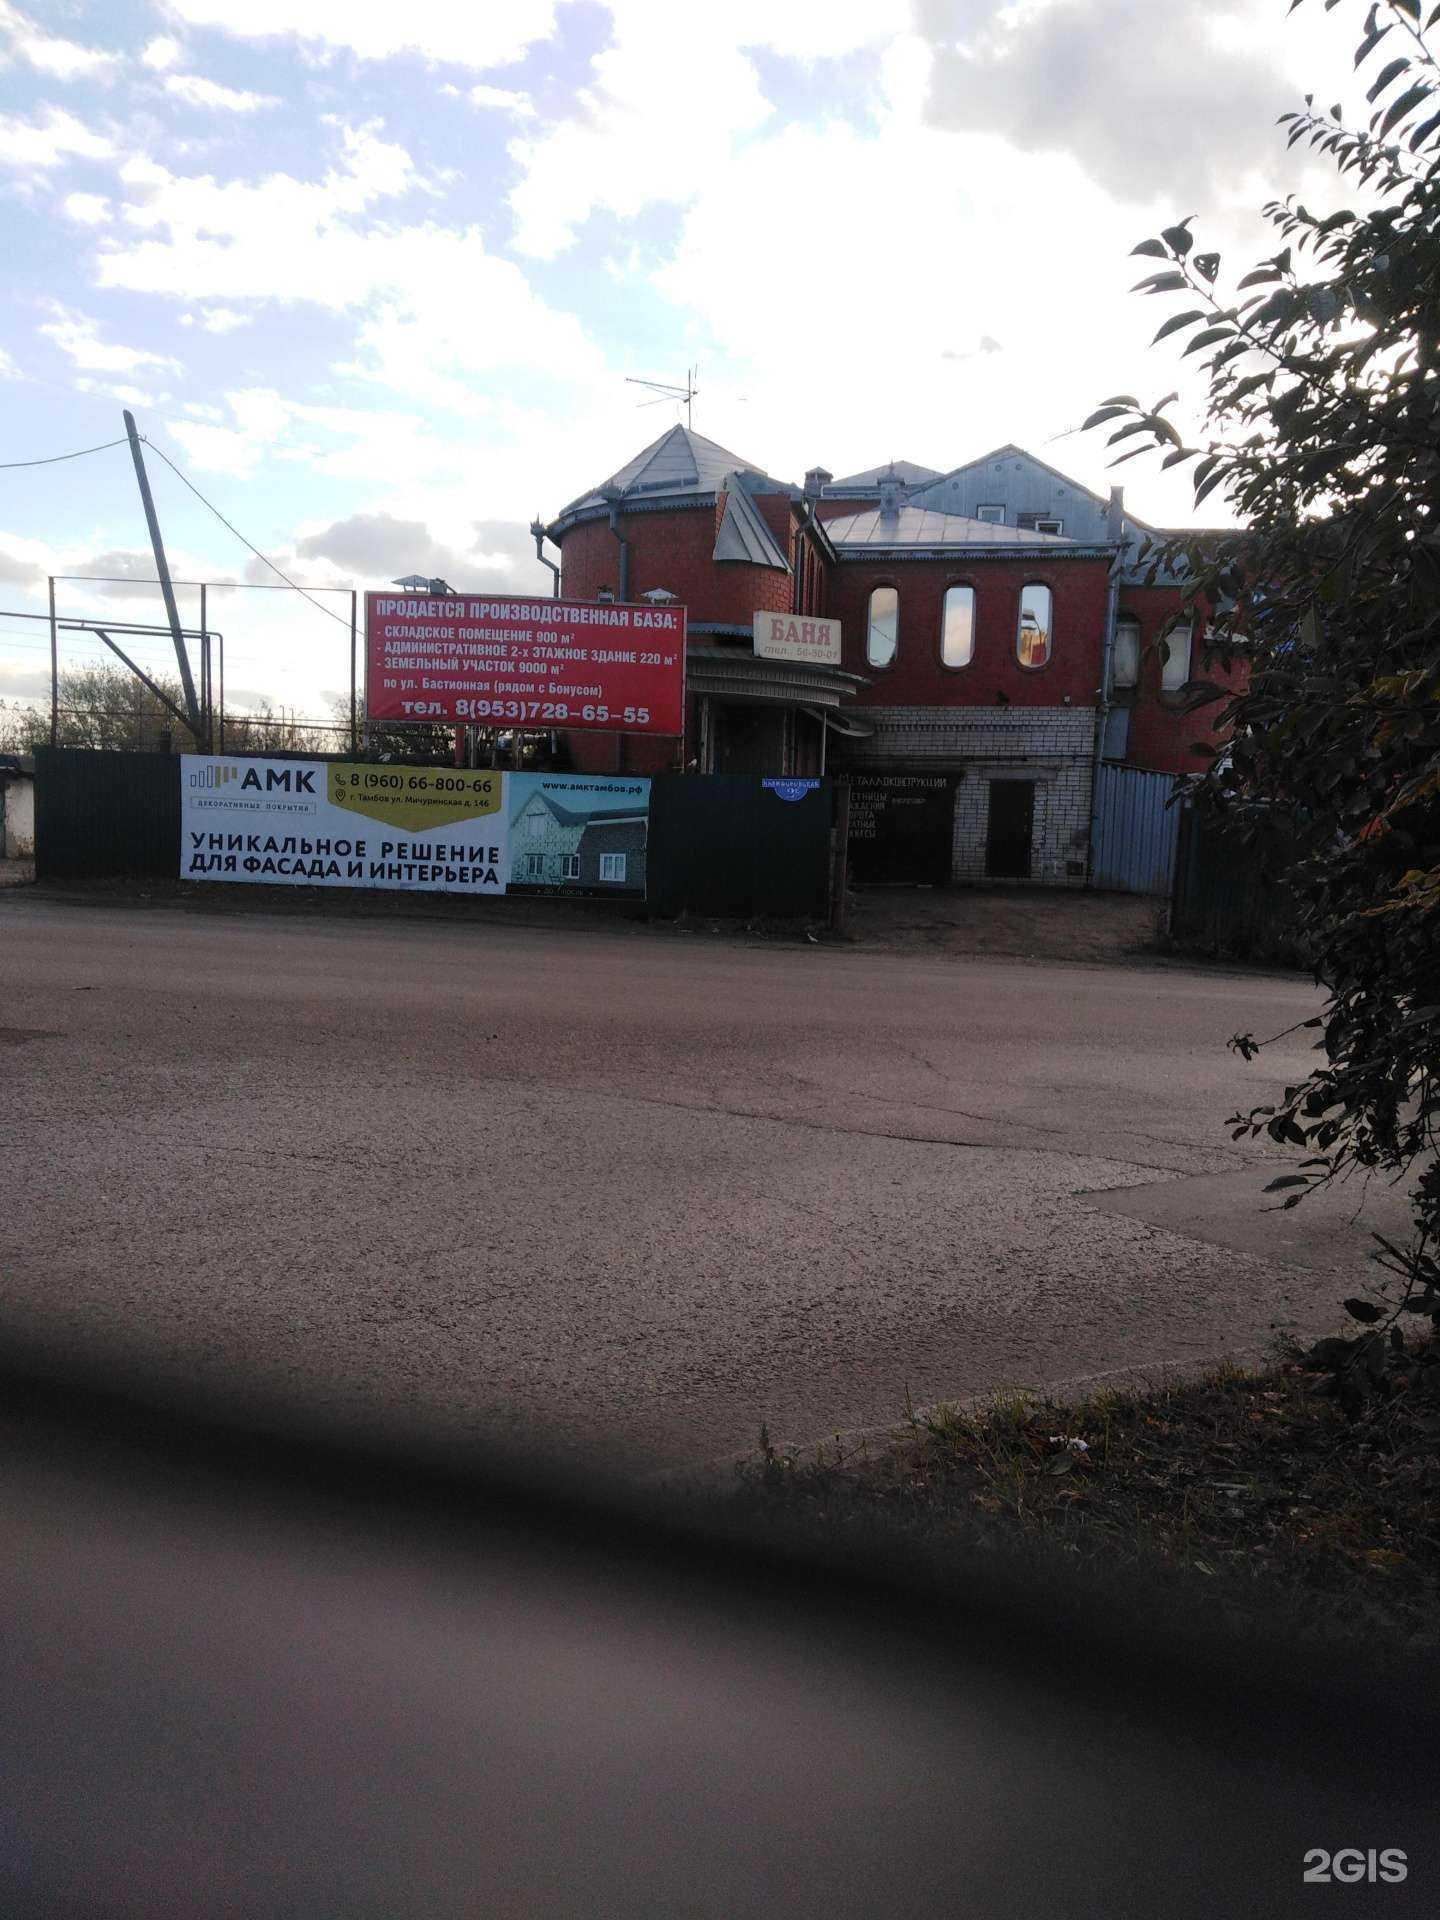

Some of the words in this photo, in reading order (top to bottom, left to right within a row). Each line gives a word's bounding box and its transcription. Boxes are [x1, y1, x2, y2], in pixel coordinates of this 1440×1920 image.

[376, 599, 465, 618] ПРОДАЕТСЯ
[470, 602, 629, 626] ПРОИЗВОДСТВЕННАЯ
[633, 611, 678, 630] БАЗА:
[384, 625, 455, 640] СКЛАДСКОЕ
[458, 627, 532, 642] ПОМЕЩЕНИЕ
[536, 631, 558, 643] 900
[770, 618, 832, 645] БАНЯ
[384, 641, 507, 657] АДМИНИСТРАТИВНОЕ
[511, 645, 529, 658] 2-х
[532, 646, 587, 661] ЭТАЖНОЕ
[591, 650, 637, 664] ЗДАНИЕ
[640, 652, 661, 665] 220
[384, 656, 459, 671] ЗЕМЕЛЬНЫЙ
[463, 659, 515, 673] УЧАСТОК
[519, 662, 547, 674] 9000
[384, 678, 397, 688] по
[401, 679, 418, 691] ул.
[422, 678, 490, 691] Бастионная
[494, 681, 535, 694] (рядом
[538, 685, 545, 694] с
[549, 682, 603, 698] Бонусом)
[401, 700, 448, 714] тел.
[455, 699, 650, 723] 8(953)728-65-55
[240, 767, 316, 793] АМК
[350, 773, 360, 786] 8
[364, 773, 404, 789] (960)
[408, 777, 492, 793] 66-800-66
[542, 782, 643, 795] www.амктамбов.рф
[198, 800, 260, 809] ДЕКОРАТИВНЫЕ
[266, 804, 309, 812] ПОКРЫТИЯ
[359, 793, 391, 802] Тамбов
[391, 796, 404, 805] ул.
[405, 796, 462, 807] Мичуринская
[190, 831, 366, 858] УНИКАЛЬНОЕ
[381, 842, 500, 864] РЕШЕНИЕ
[189, 853, 237, 873] ДЛЯ
[243, 855, 342, 879] ФАСАДА
[347, 861, 362, 879] И
[370, 862, 500, 884] ИНТЕРЬЕРА
